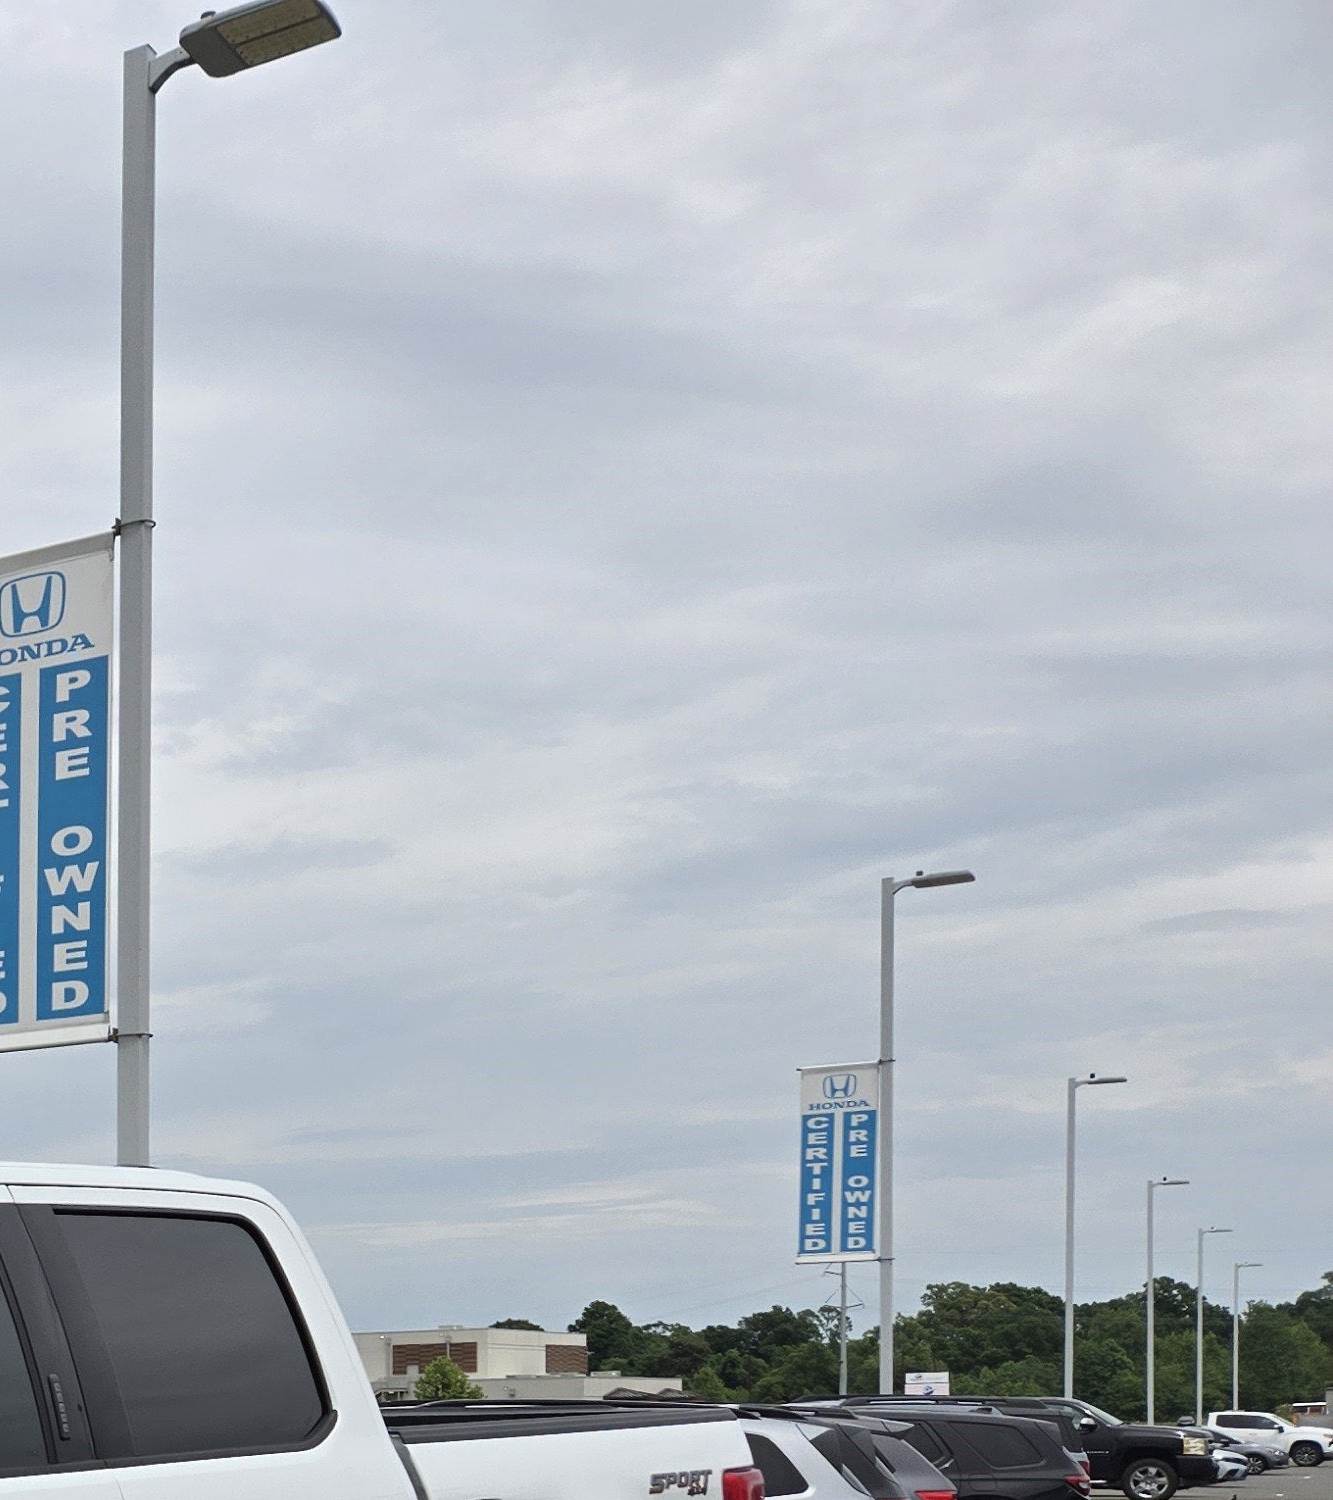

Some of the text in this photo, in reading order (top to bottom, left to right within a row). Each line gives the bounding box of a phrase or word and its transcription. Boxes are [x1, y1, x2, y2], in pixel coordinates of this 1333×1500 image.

[44, 668, 100, 1012] PRE OWNED
[808, 1099, 871, 1111] HONDA
[804, 1116, 830, 1251] CERTIFIED
[844, 1113, 872, 1250] PRE OWNED
[649, 1468, 713, 1496] SPORT
